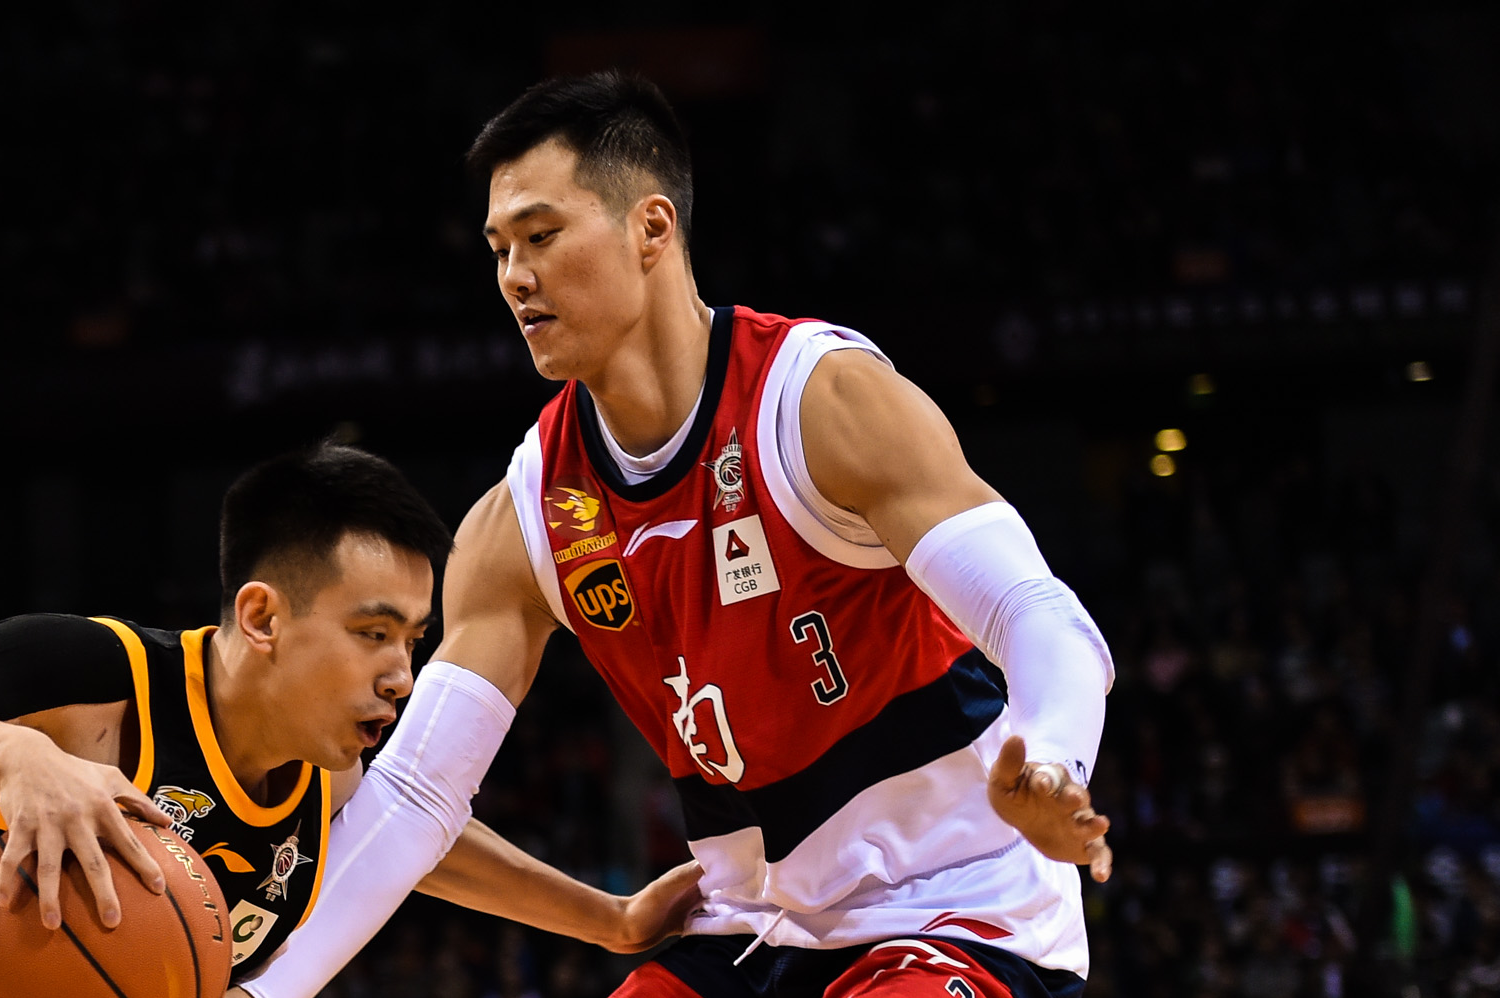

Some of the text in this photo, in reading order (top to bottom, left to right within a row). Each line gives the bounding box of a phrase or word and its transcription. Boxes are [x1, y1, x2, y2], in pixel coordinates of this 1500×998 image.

[725, 563, 762, 583] 广发银行
[734, 579, 758, 594] CGB
[789, 610, 849, 706] 3
